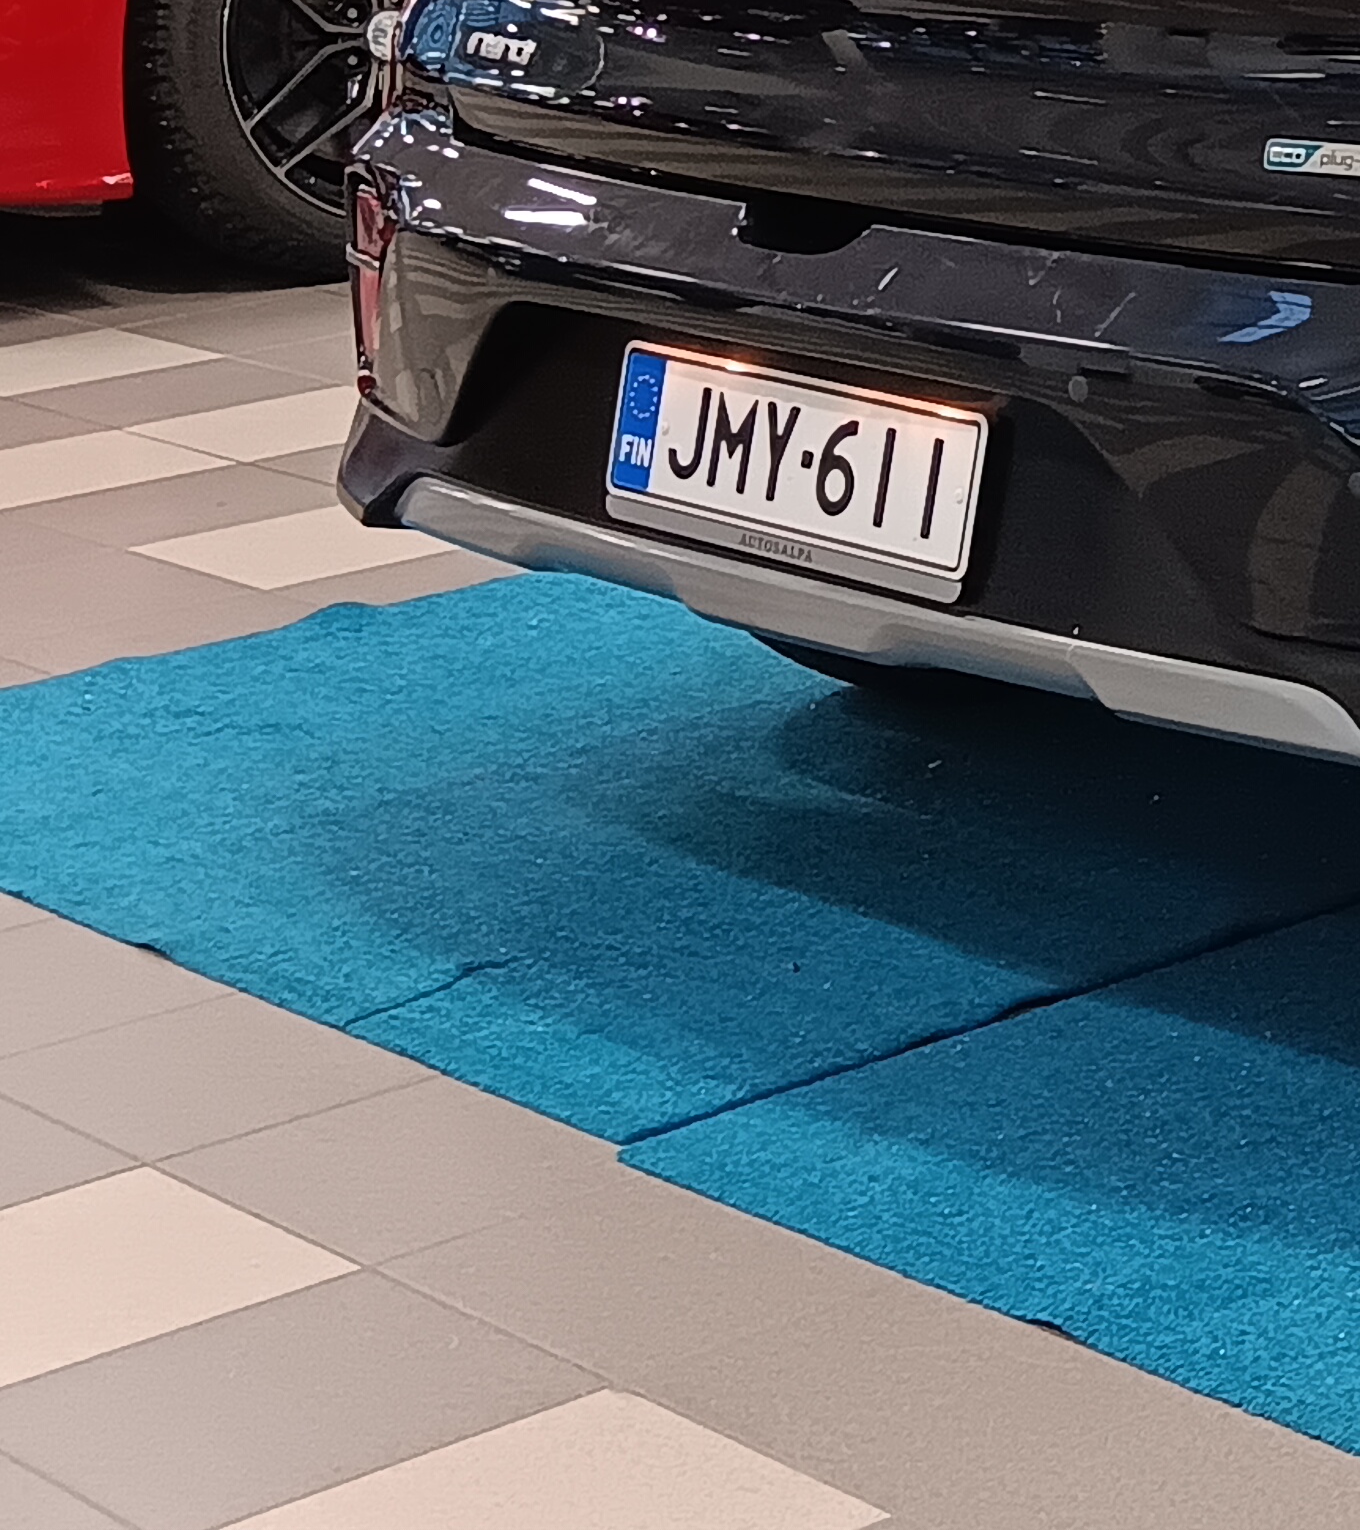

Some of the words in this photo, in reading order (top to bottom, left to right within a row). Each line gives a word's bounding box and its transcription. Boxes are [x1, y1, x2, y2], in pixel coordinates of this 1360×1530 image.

[618, 433, 654, 469] FIN
[668, 386, 945, 540] JMY-611
[738, 533, 813, 564] AUTOSALPA
